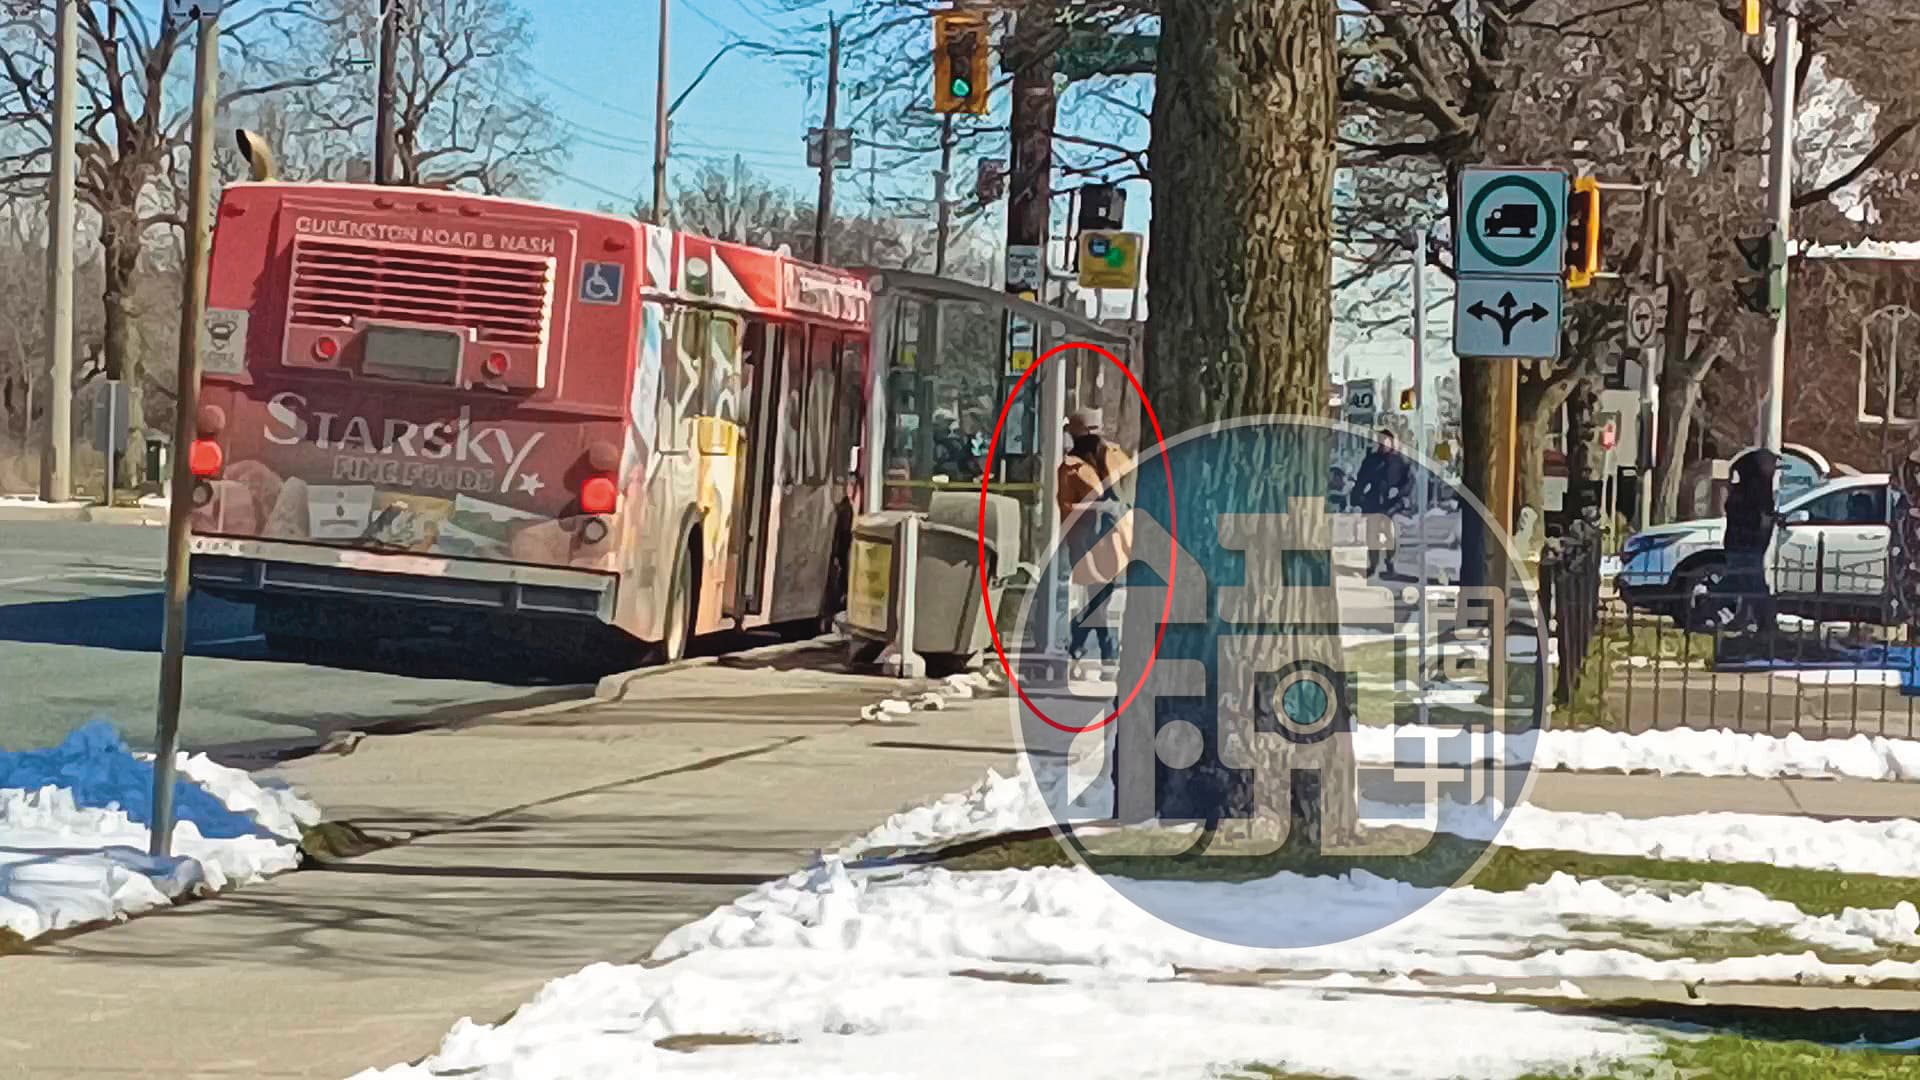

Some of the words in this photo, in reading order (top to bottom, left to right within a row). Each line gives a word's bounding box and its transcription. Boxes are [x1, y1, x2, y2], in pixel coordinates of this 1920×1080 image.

[295, 216, 417, 242] QUEENSTON
[422, 228, 477, 248] ROAD
[481, 234, 495, 249] &
[501, 236, 556, 254] NASH
[332, 454, 399, 483] FINE
[401, 461, 495, 493] FOODS
